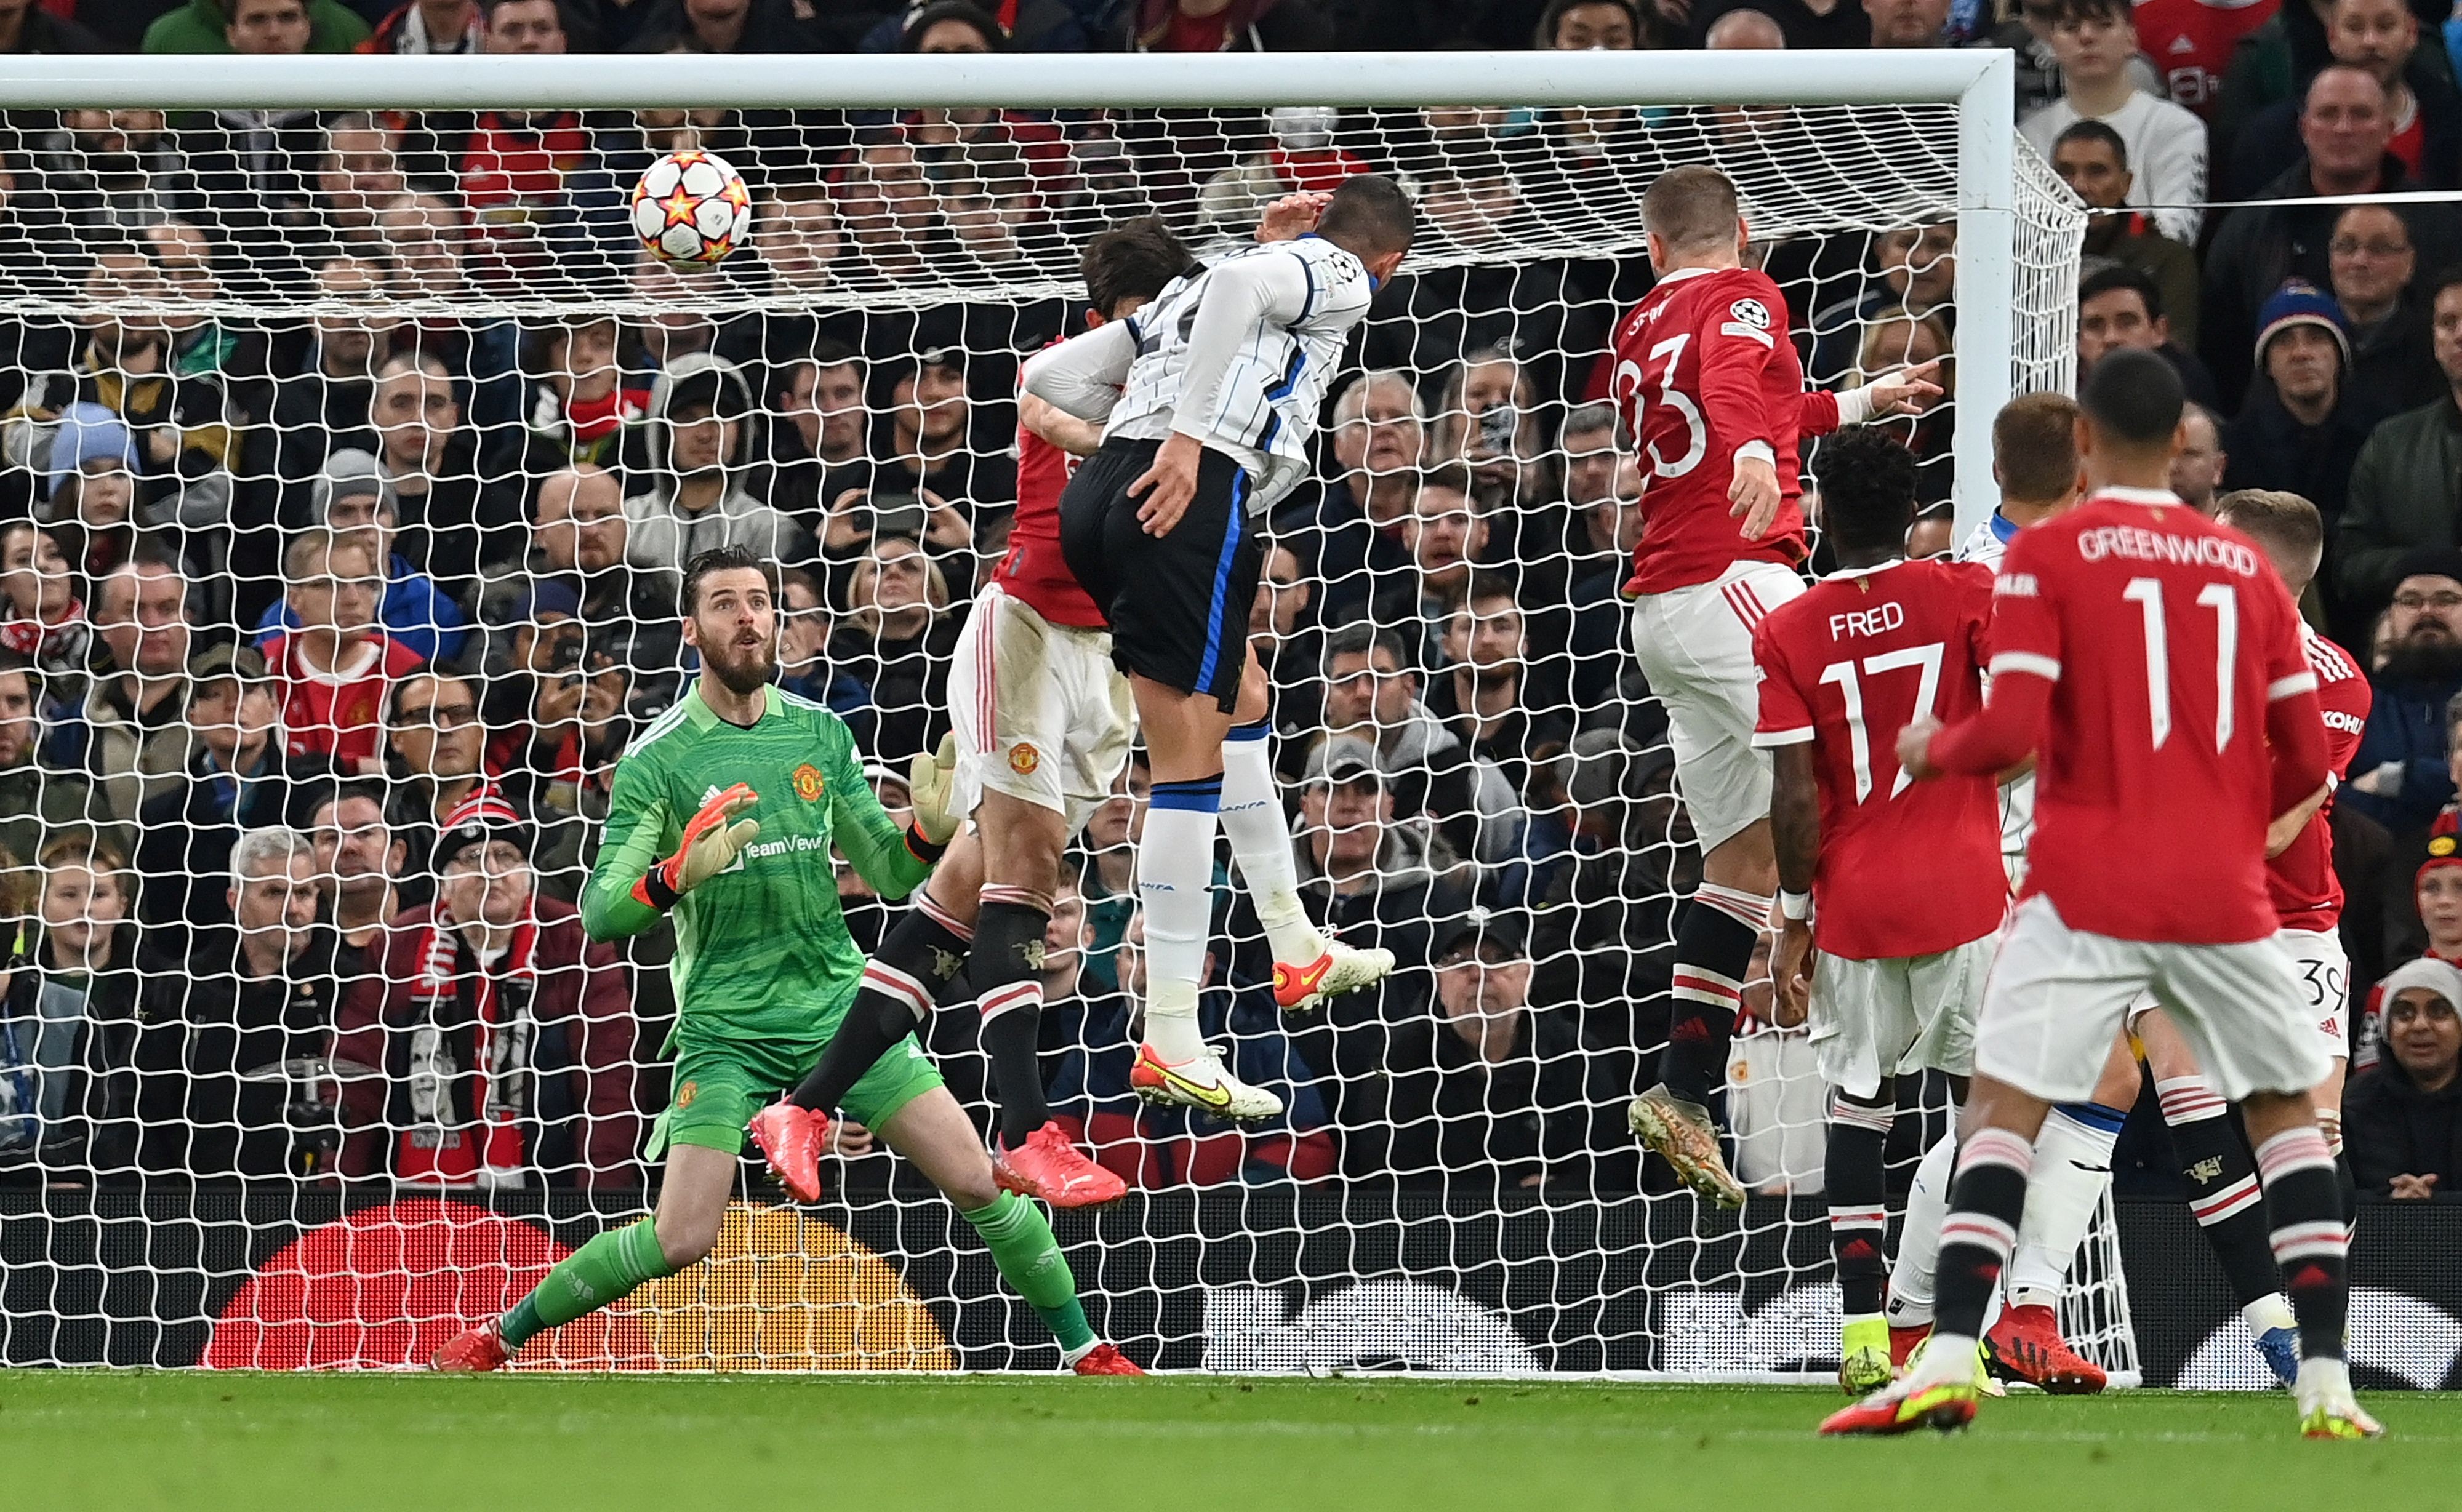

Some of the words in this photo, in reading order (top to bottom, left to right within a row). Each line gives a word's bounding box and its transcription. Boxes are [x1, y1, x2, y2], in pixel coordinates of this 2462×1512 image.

[2078, 525, 2258, 577] GREENWOOD
[1829, 602, 1904, 642] FRED
[2123, 577, 2237, 755] 11
[1818, 642, 1945, 807] 17
[2320, 710, 2365, 735] KOHL
[2296, 959, 2343, 1012] 39
